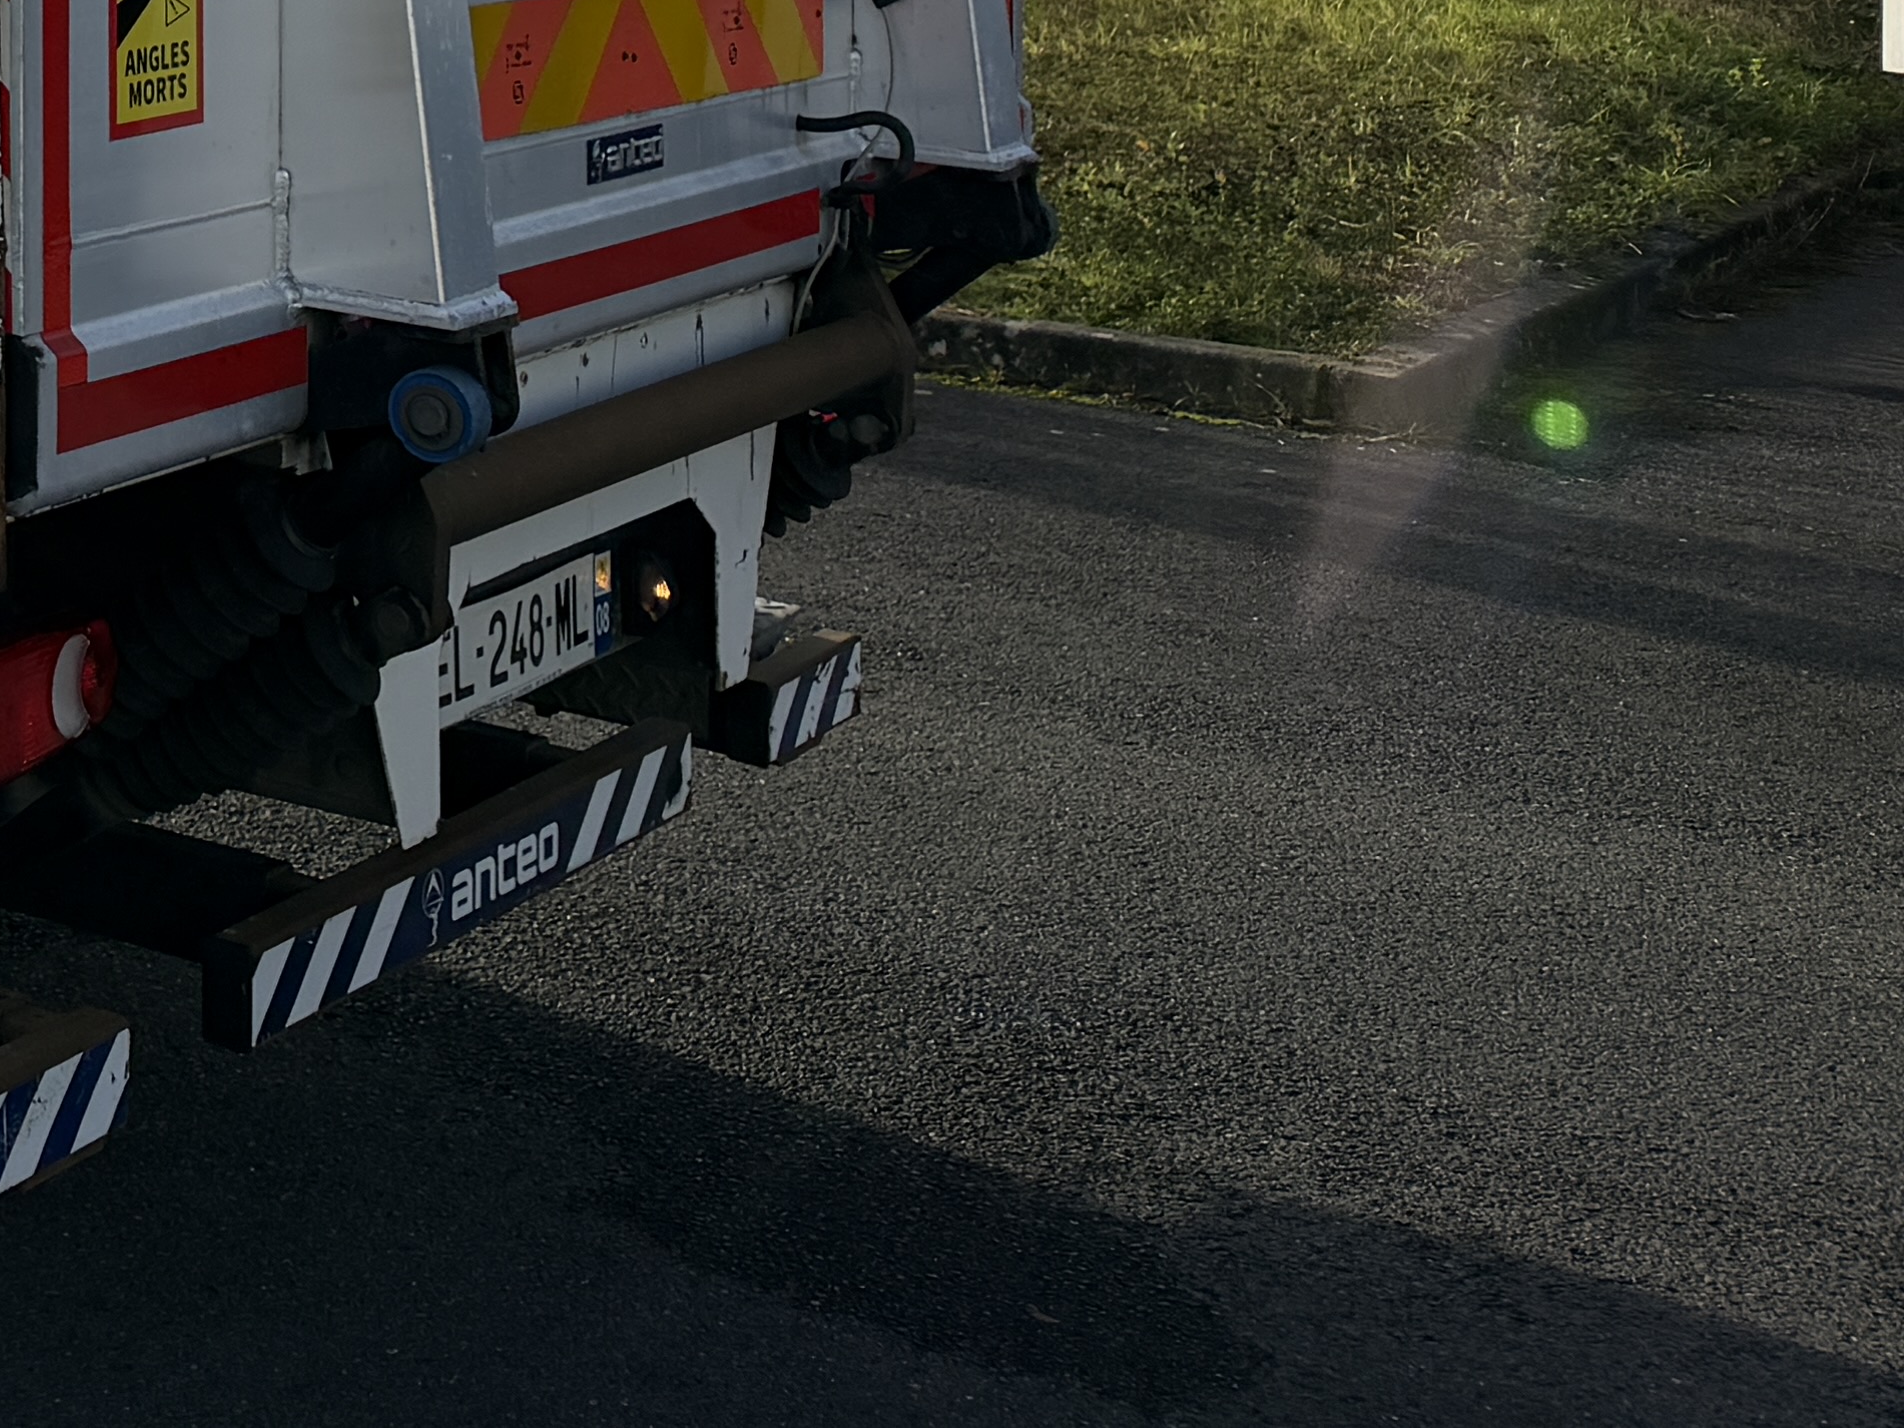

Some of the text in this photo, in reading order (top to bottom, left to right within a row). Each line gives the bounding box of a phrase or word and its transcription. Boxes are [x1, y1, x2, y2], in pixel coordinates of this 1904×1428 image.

[124, 40, 190, 77] ANGLES
[128, 73, 188, 109] MORTS
[451, 821, 559, 921] anteo
